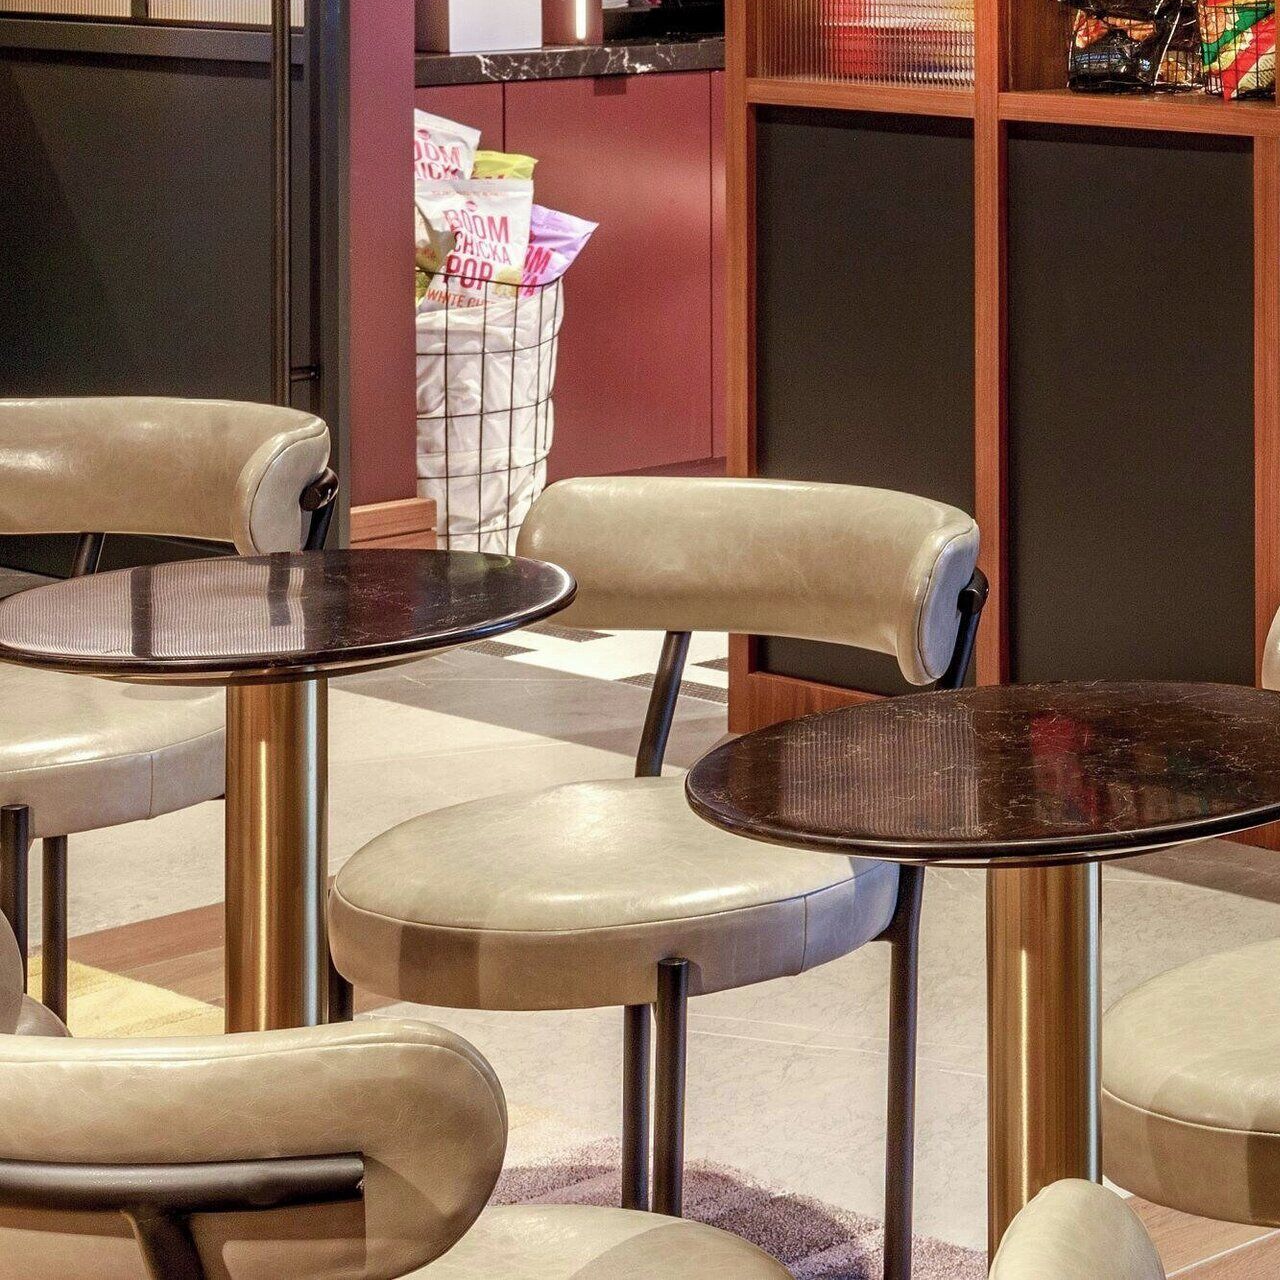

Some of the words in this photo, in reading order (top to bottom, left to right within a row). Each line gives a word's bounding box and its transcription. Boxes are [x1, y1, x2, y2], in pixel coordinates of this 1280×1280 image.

[414, 140, 462, 167] OOM
[443, 209, 510, 243] BOOM
[453, 231, 512, 265] CHICKA
[444, 255, 493, 290] POP
[426, 288, 464, 308] WHITE
